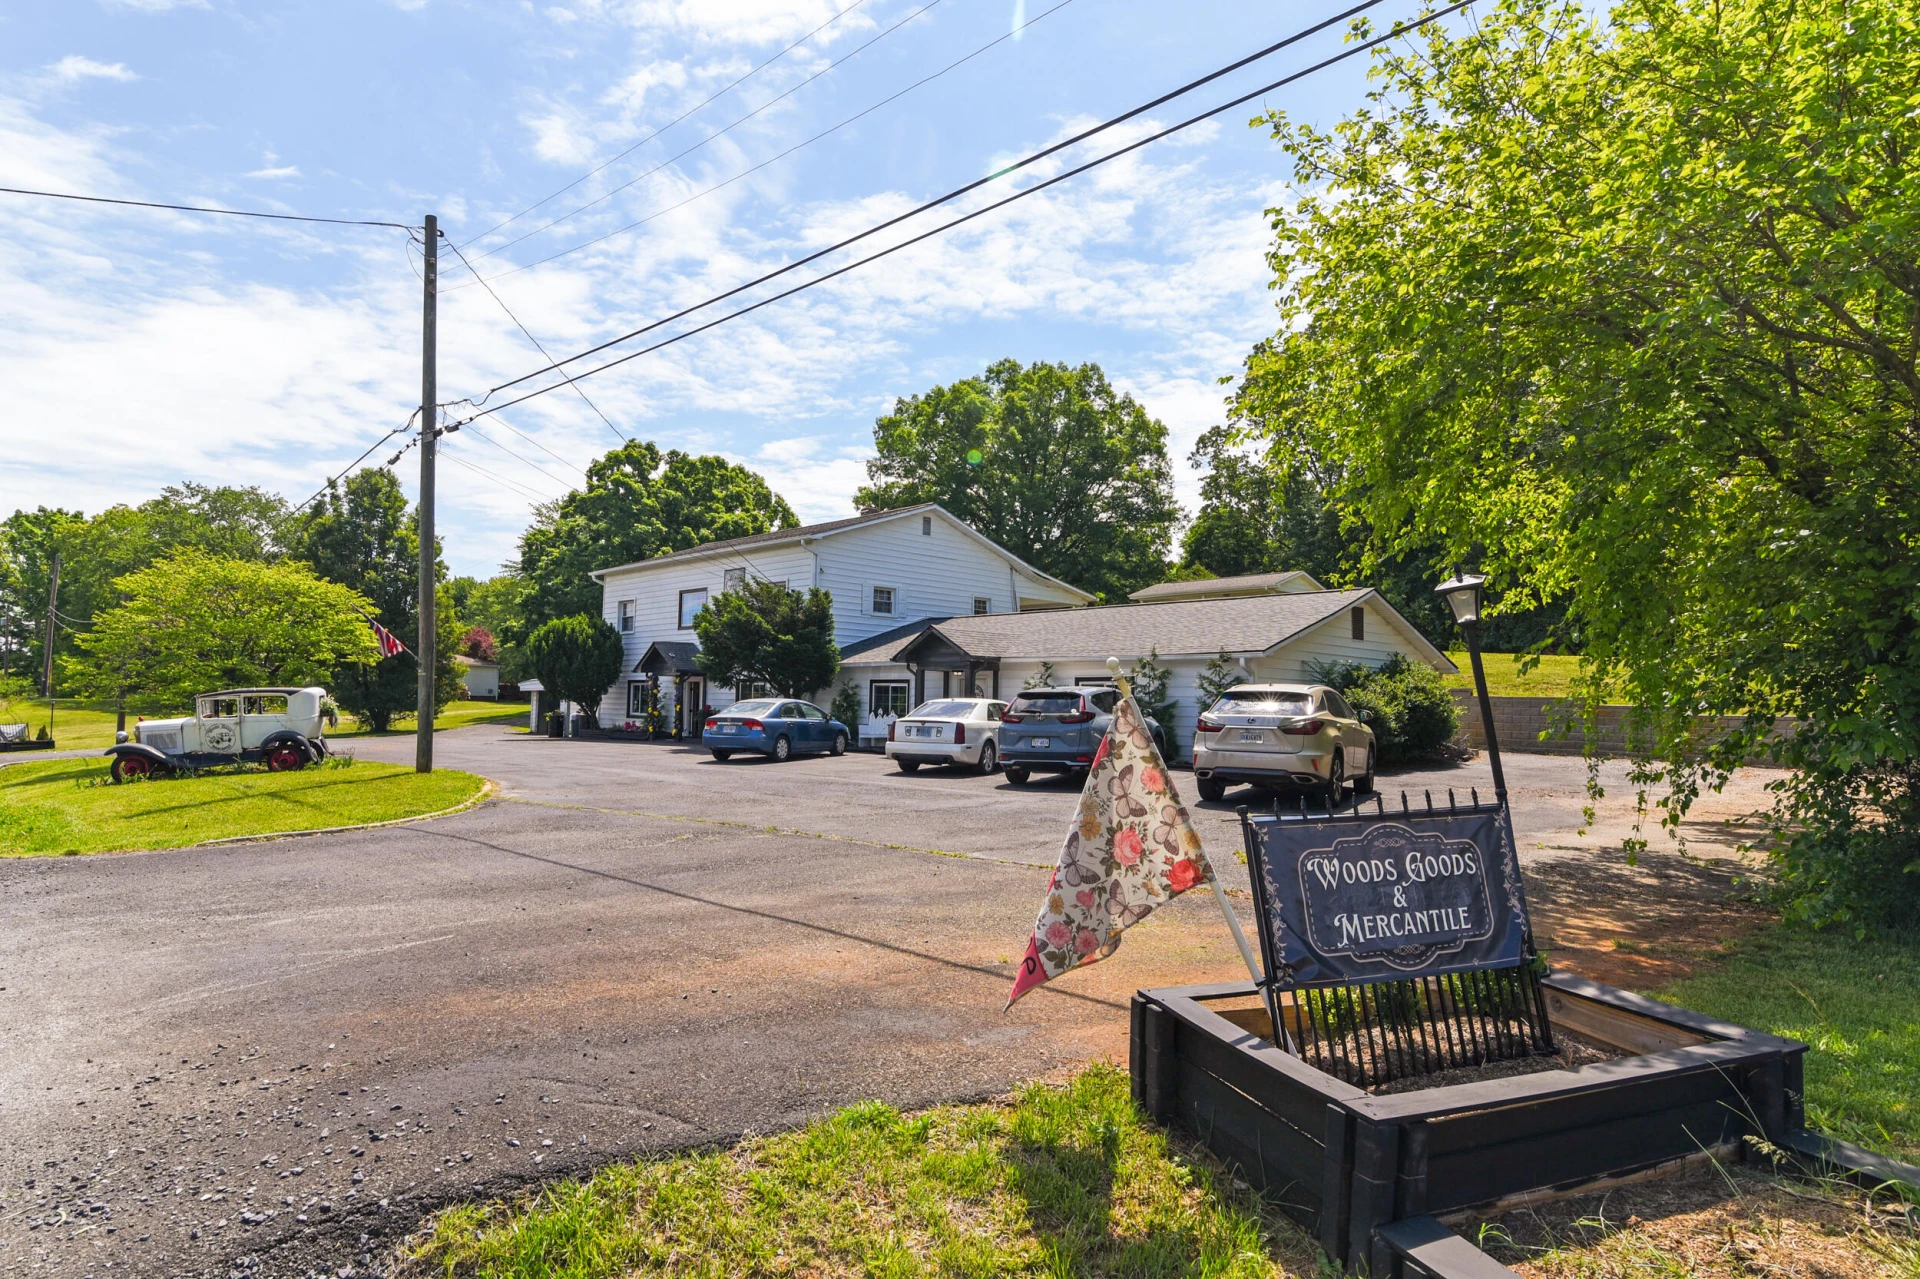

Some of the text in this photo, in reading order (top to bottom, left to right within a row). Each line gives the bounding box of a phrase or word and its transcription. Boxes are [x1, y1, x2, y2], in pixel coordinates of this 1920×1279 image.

[1307, 852, 1477, 890] WOODS GOODS
[1393, 885, 1407, 908] &
[1334, 906, 1471, 948] MERCANTILE
